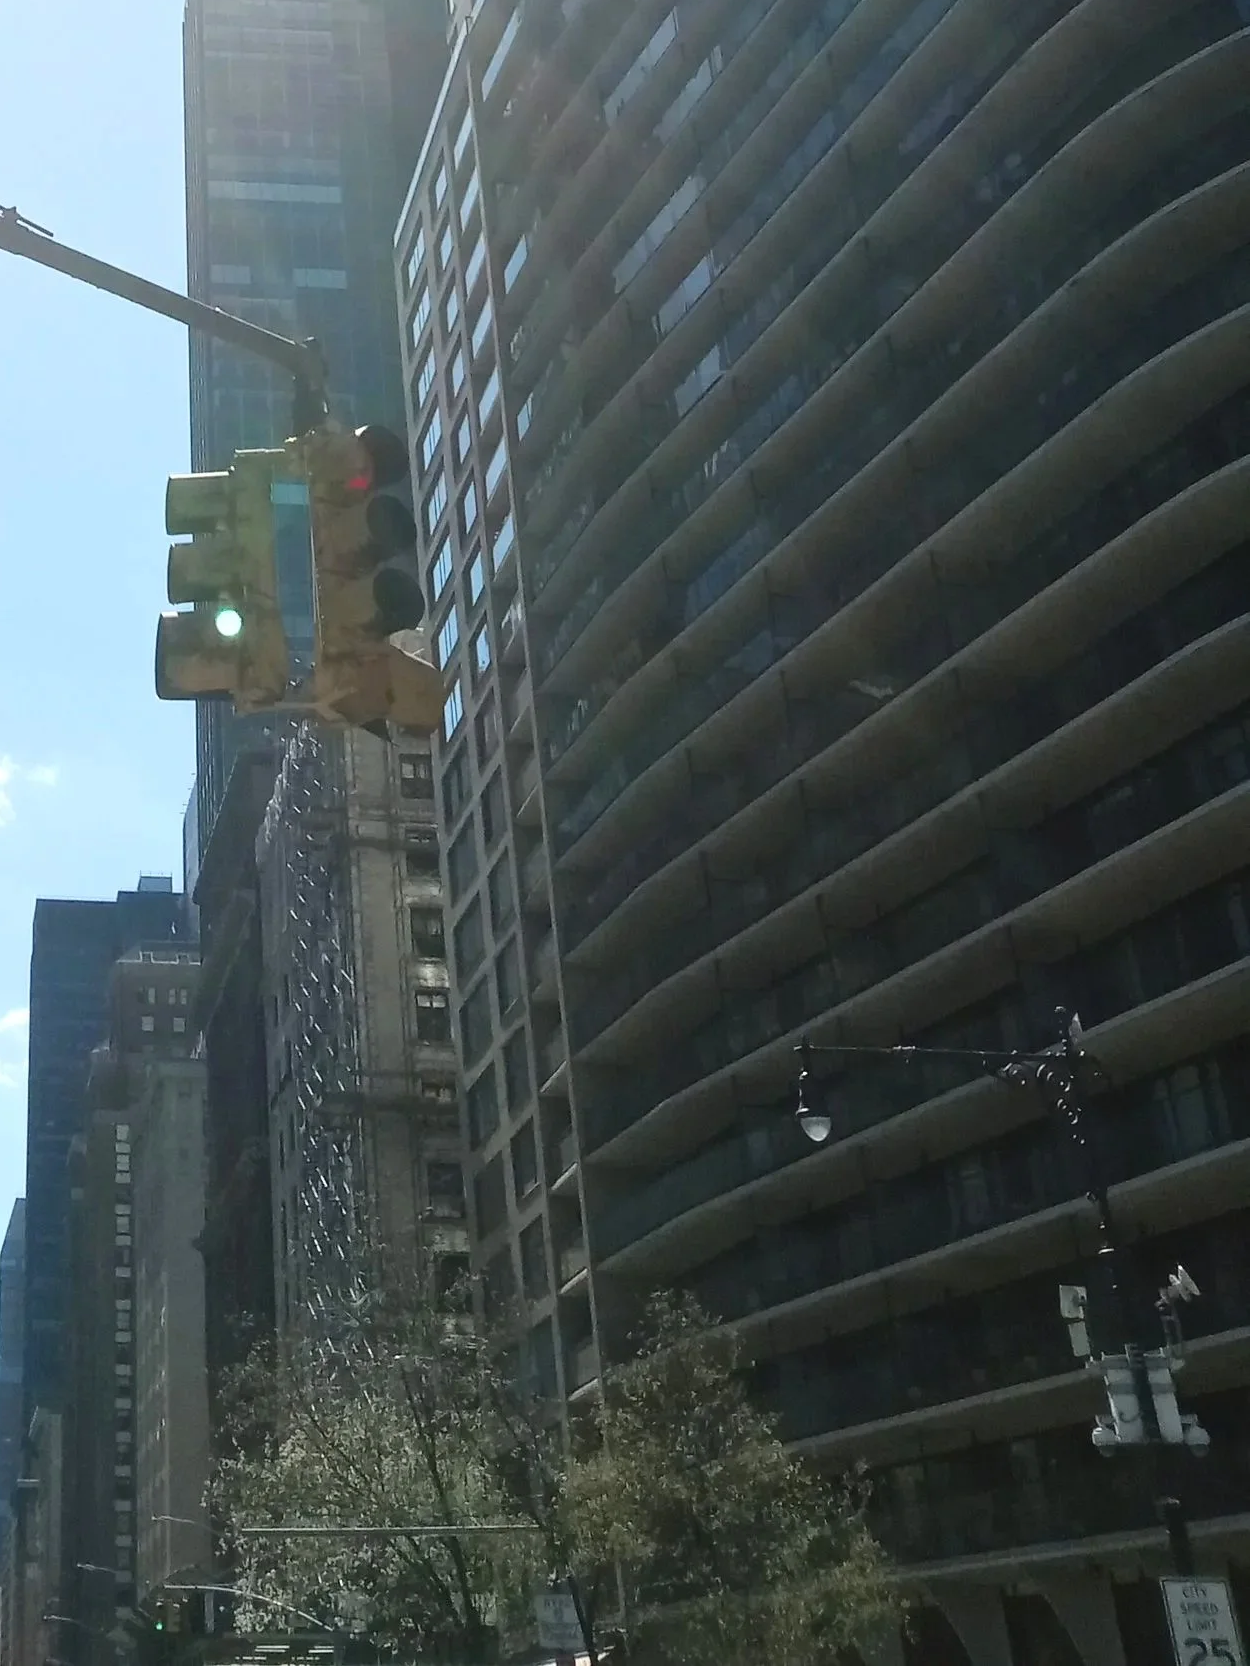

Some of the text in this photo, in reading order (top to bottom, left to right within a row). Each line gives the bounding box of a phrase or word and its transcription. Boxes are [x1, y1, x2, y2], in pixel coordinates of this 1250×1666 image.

[1182, 1586, 1208, 1598] CITY
[1180, 1602, 1220, 1615] SPEED
[1186, 1618, 1218, 1631] LIMIT
[1184, 1637, 1237, 1666] 25
